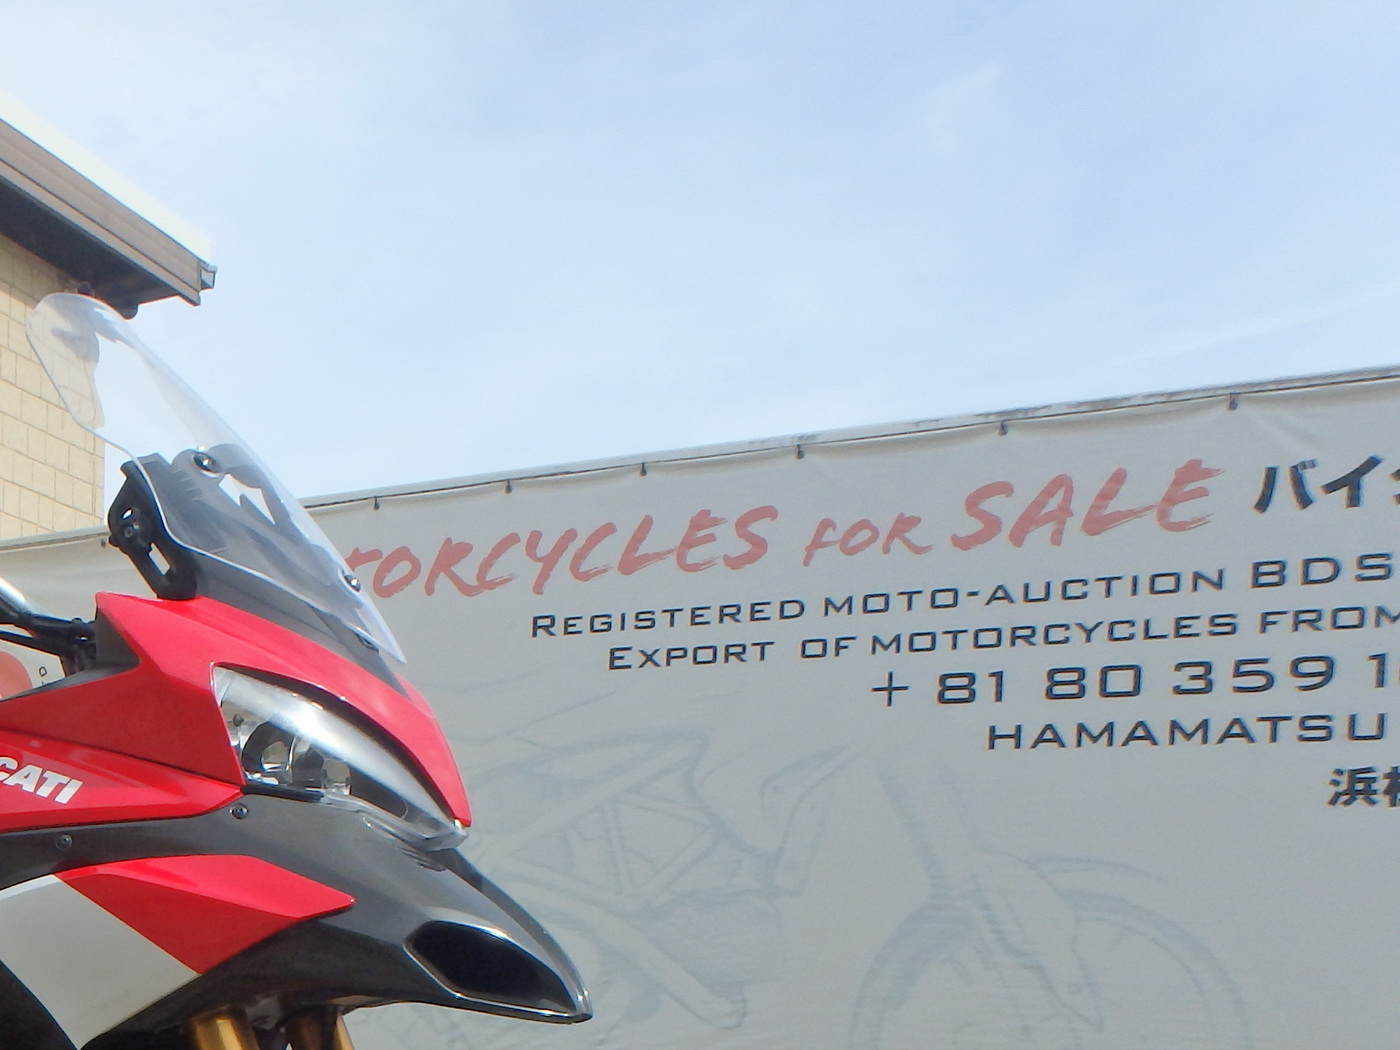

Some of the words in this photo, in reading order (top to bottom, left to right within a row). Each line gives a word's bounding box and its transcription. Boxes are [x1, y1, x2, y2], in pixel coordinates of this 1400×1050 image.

[950, 458, 1225, 552] SALE
[1253, 455, 1400, 514] バイ
[531, 599, 806, 638] REGISTERED
[823, 568, 1225, 617] MOTO-AUCTION
[1250, 552, 1394, 589] BDS
[608, 641, 775, 671] EXPORT
[800, 636, 857, 660] OF
[871, 613, 1238, 655] MOTORCYCLES
[1259, 605, 1400, 634] FROM
[937, 670, 1005, 705] 81
[1045, 664, 1142, 700] 80
[987, 712, 1387, 750] HAMAMATSU
